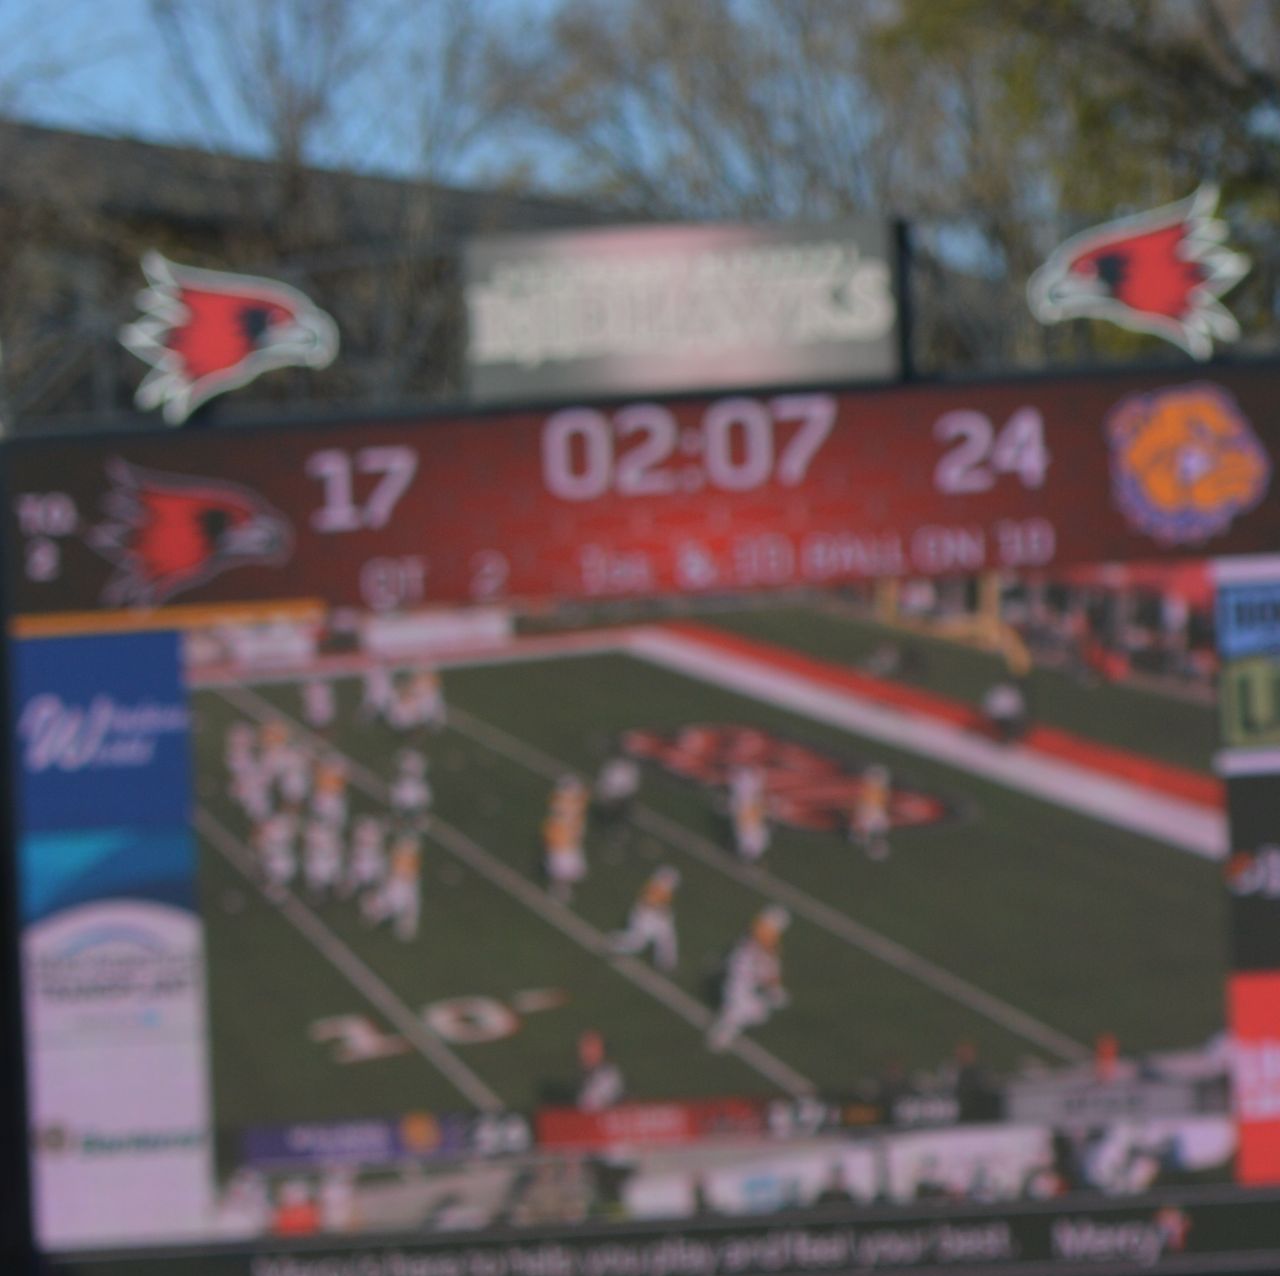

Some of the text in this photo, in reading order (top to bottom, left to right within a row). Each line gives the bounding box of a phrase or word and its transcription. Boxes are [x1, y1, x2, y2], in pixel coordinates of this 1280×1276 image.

[306, 445, 417, 532] 17
[541, 394, 839, 501] 02:07
[933, 407, 1047, 494] 24
[1052, 1220, 1162, 1268] Mercy
